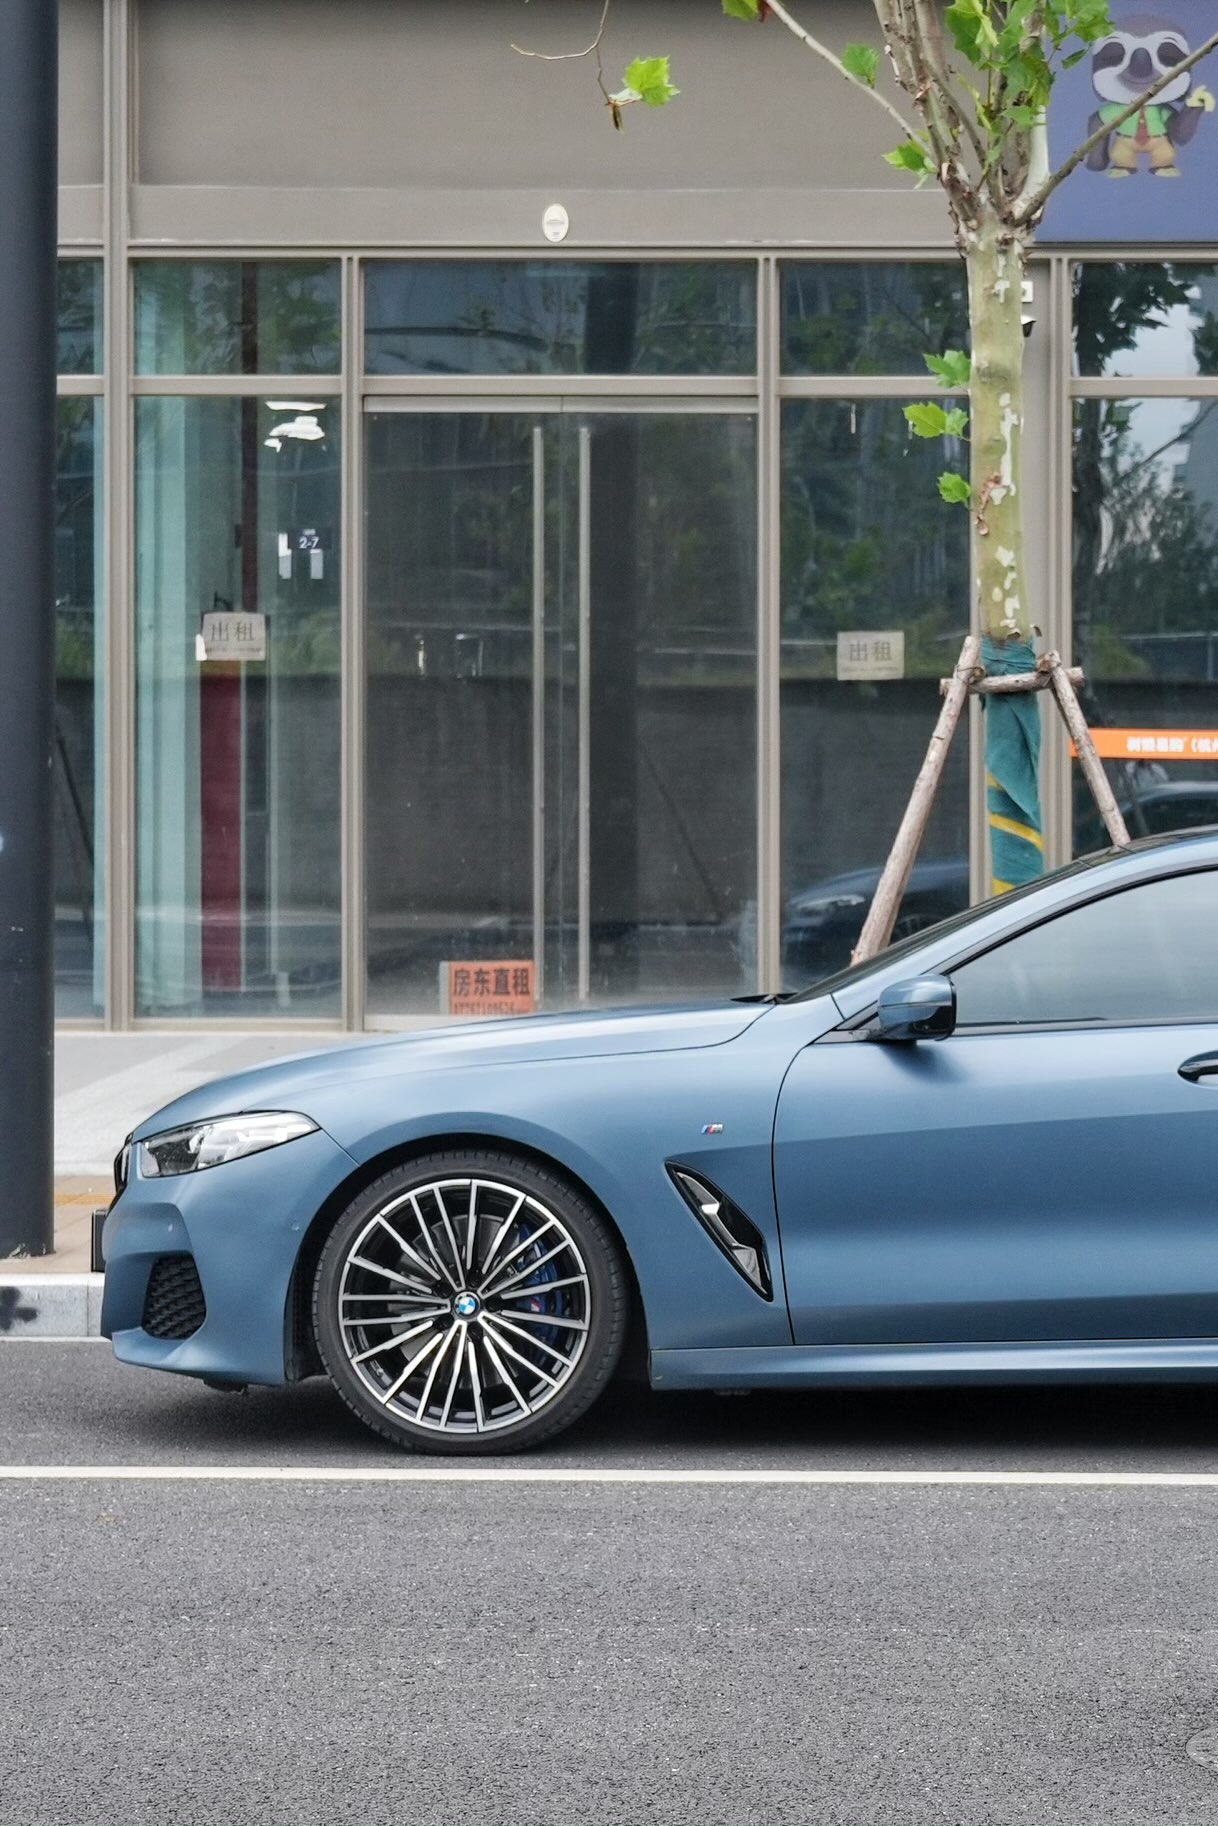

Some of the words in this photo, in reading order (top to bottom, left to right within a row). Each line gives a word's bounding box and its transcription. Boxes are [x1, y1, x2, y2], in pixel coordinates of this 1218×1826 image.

[299, 536, 319, 549] 2-7
[209, 621, 255, 641] 出租
[848, 641, 892, 662] 出租
[454, 968, 531, 997] 房东直租
